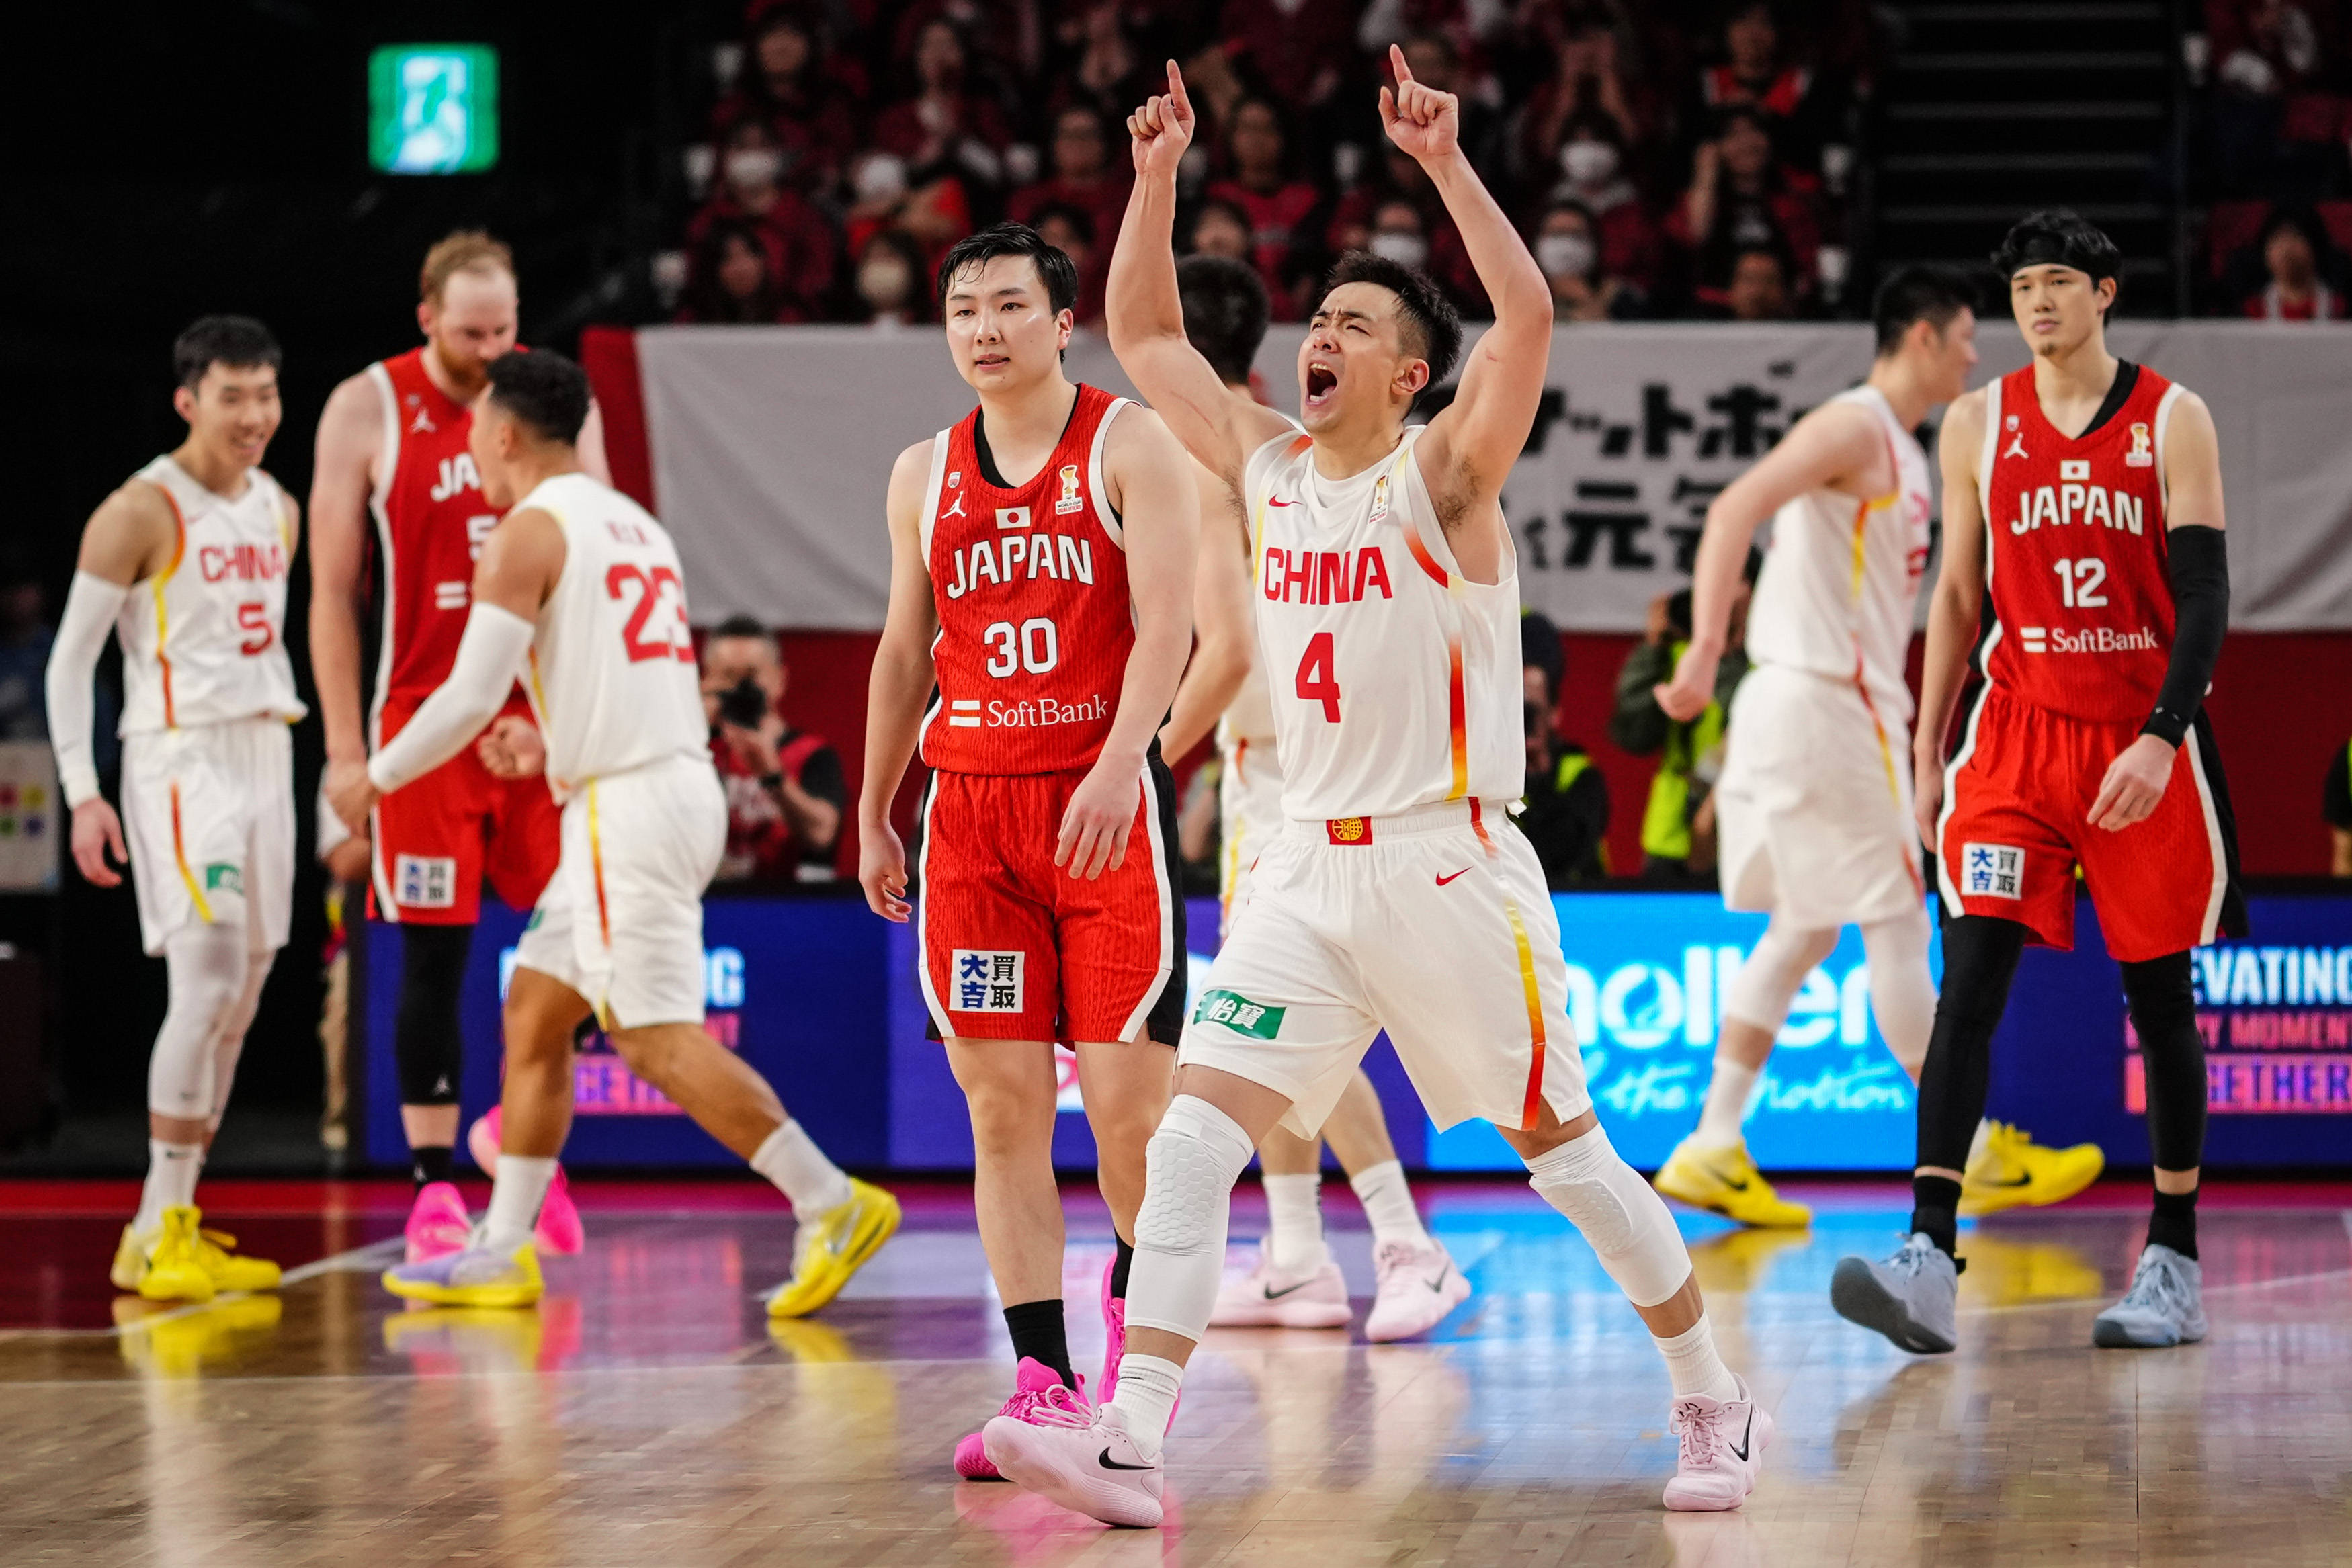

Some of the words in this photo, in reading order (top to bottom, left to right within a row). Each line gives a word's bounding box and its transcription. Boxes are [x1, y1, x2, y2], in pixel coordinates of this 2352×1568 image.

[2010, 484, 2143, 537] JAPAN
[946, 533, 1094, 599] JAPAN
[1264, 546, 1392, 605] CHINA
[2054, 557, 2109, 609] 12
[237, 602, 274, 656] 5
[605, 563, 696, 664] 23
[2052, 626, 2158, 653] SoftBank
[983, 617, 1058, 679] 30
[1295, 632, 1341, 723] 4
[986, 693, 1109, 728] SoftBank
[960, 953, 989, 1009] 大吉
[989, 955, 1016, 1009] 買取
